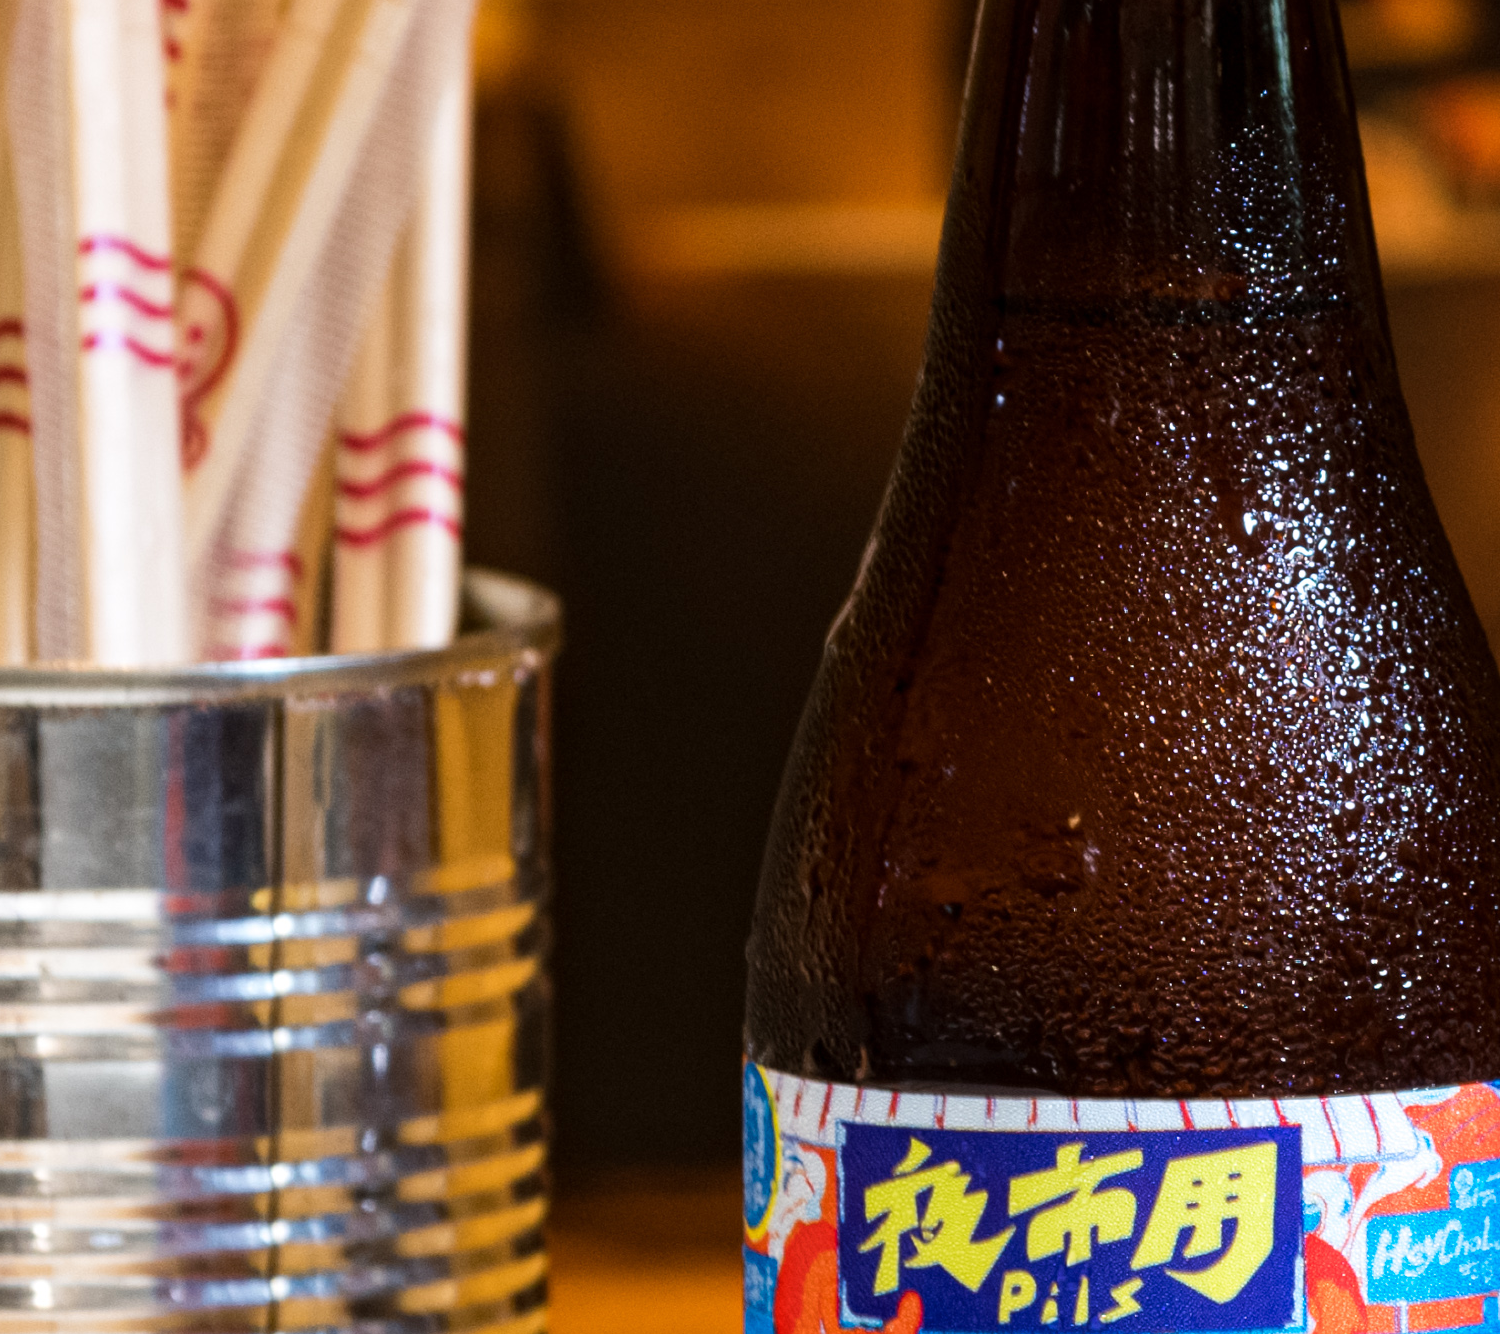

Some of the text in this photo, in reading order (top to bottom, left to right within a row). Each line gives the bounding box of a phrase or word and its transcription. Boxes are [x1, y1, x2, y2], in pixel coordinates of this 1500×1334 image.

[856, 1137, 1279, 1304] 夜市用
[998, 1269, 1143, 1323] Pils
